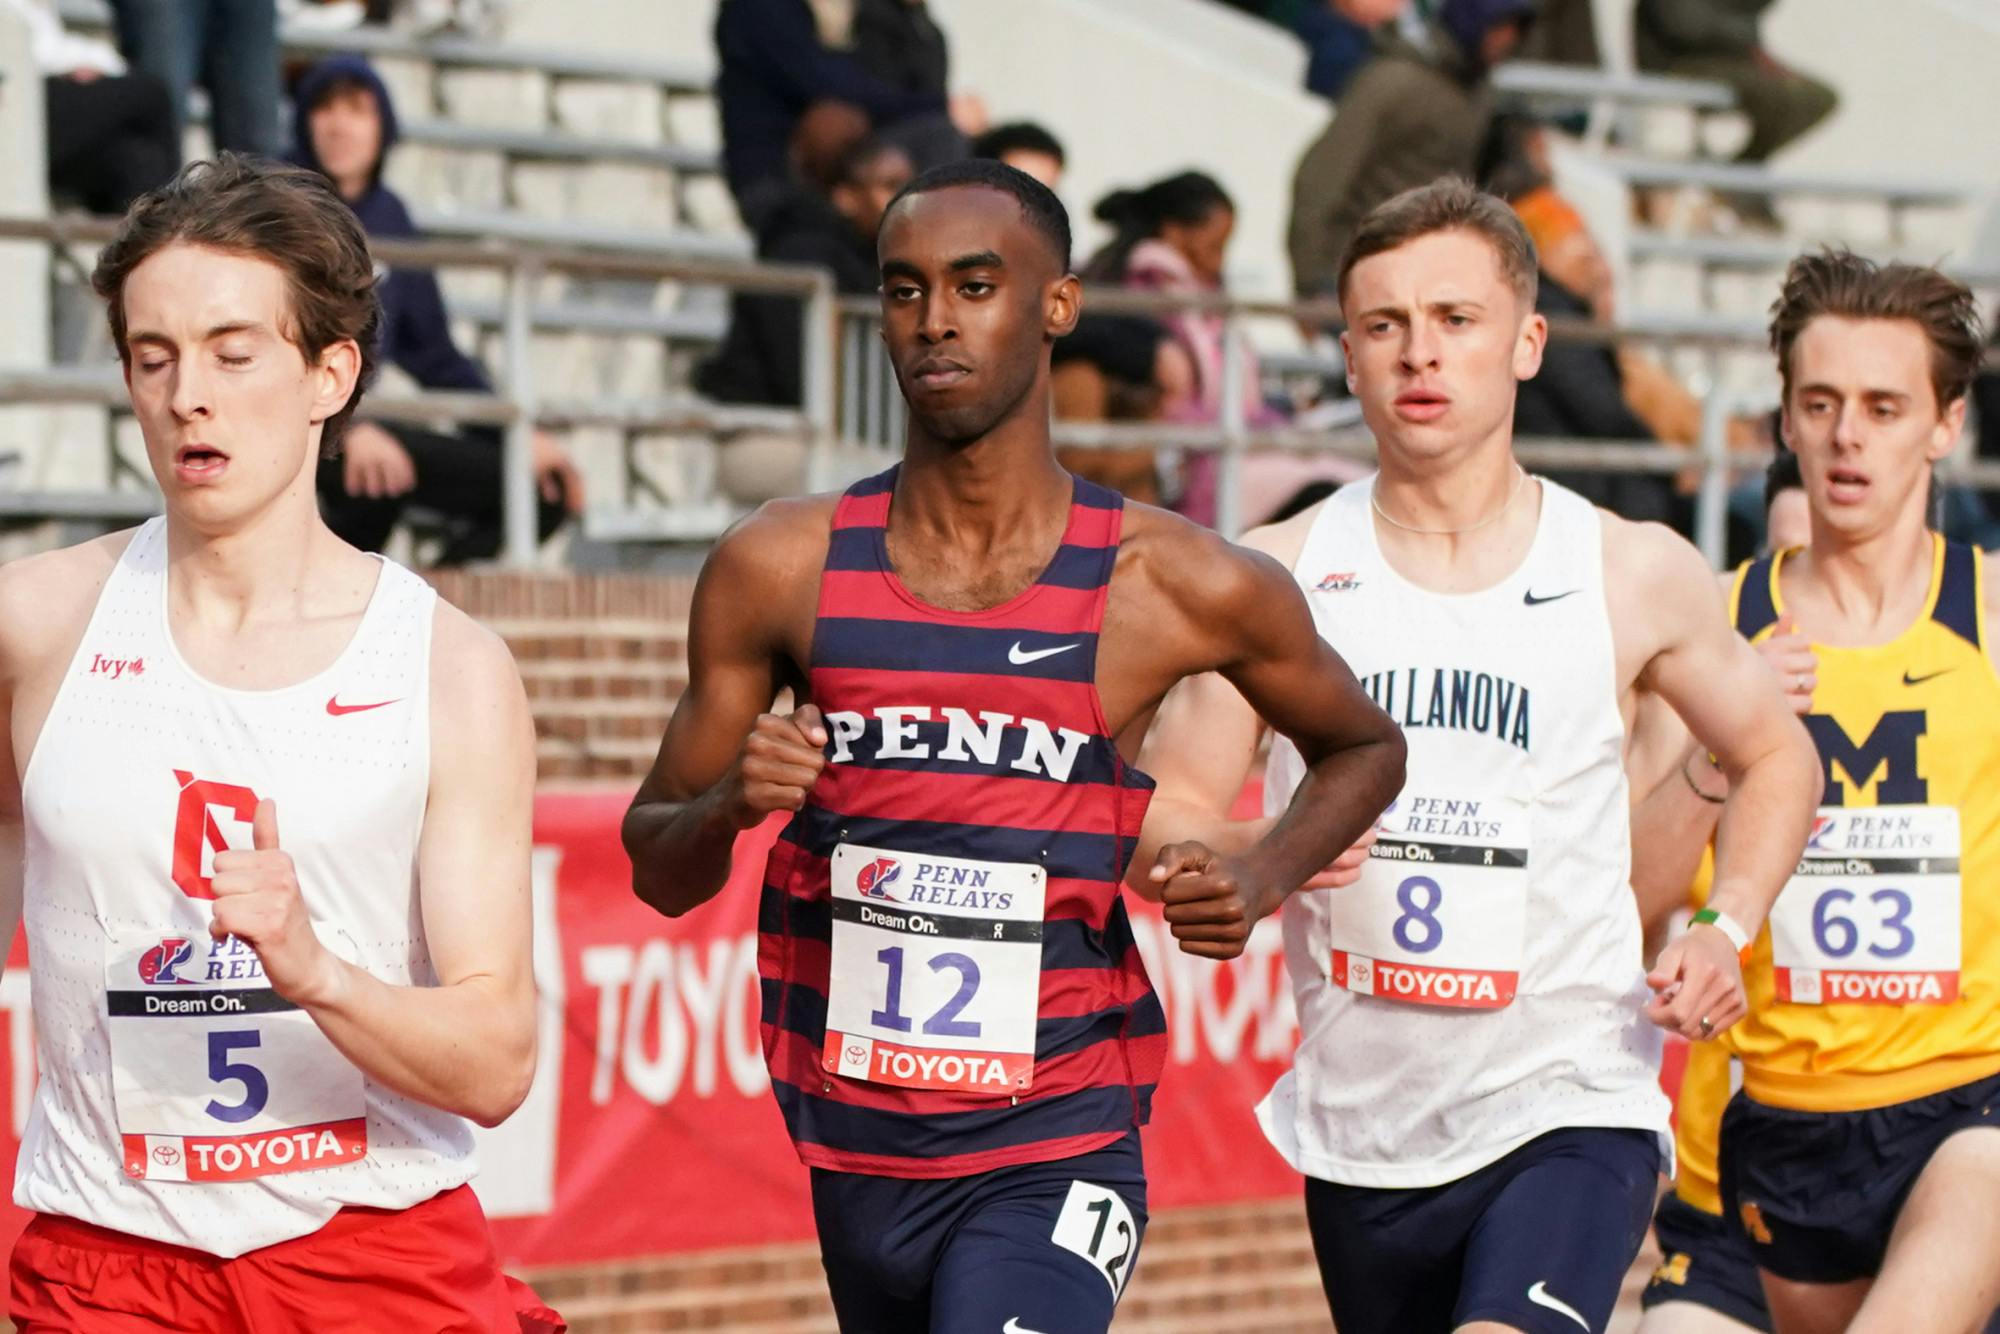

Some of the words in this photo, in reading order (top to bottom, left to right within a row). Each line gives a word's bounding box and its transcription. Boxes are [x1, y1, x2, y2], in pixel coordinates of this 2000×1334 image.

[89, 653, 127, 680] Ivy
[1361, 667, 1530, 752] ILLANOVA
[826, 705, 1090, 783] PENN
[1802, 710, 1927, 806] M
[1411, 797, 1482, 817] PENN
[1405, 816, 1502, 838] RELAYS
[1850, 816, 1912, 831] PENN
[1370, 844, 1403, 859] eam
[1405, 844, 1435, 862] On.
[1845, 834, 1933, 849] RELAYS
[914, 863, 991, 888] PENN
[908, 884, 1013, 910] RELAYS
[860, 906, 906, 931] Dream
[908, 915, 939, 935] On.
[1392, 875, 1443, 954] 8
[1812, 889, 1915, 959] 63
[208, 936, 258, 958] PE
[205, 959, 263, 981] REL
[1378, 967, 1498, 1001] TOYOTA
[871, 946, 982, 1038] 12
[1826, 973, 1942, 1000] TOYOTA
[145, 996, 207, 1013] Dream
[210, 994, 246, 1012] On.
[580, 930, 772, 1106] TOYO
[205, 1029, 269, 1124] 5
[877, 1048, 1009, 1086] TOYOTA
[191, 1130, 344, 1173] TOYOTA
[1086, 1197, 1132, 1295] 12
